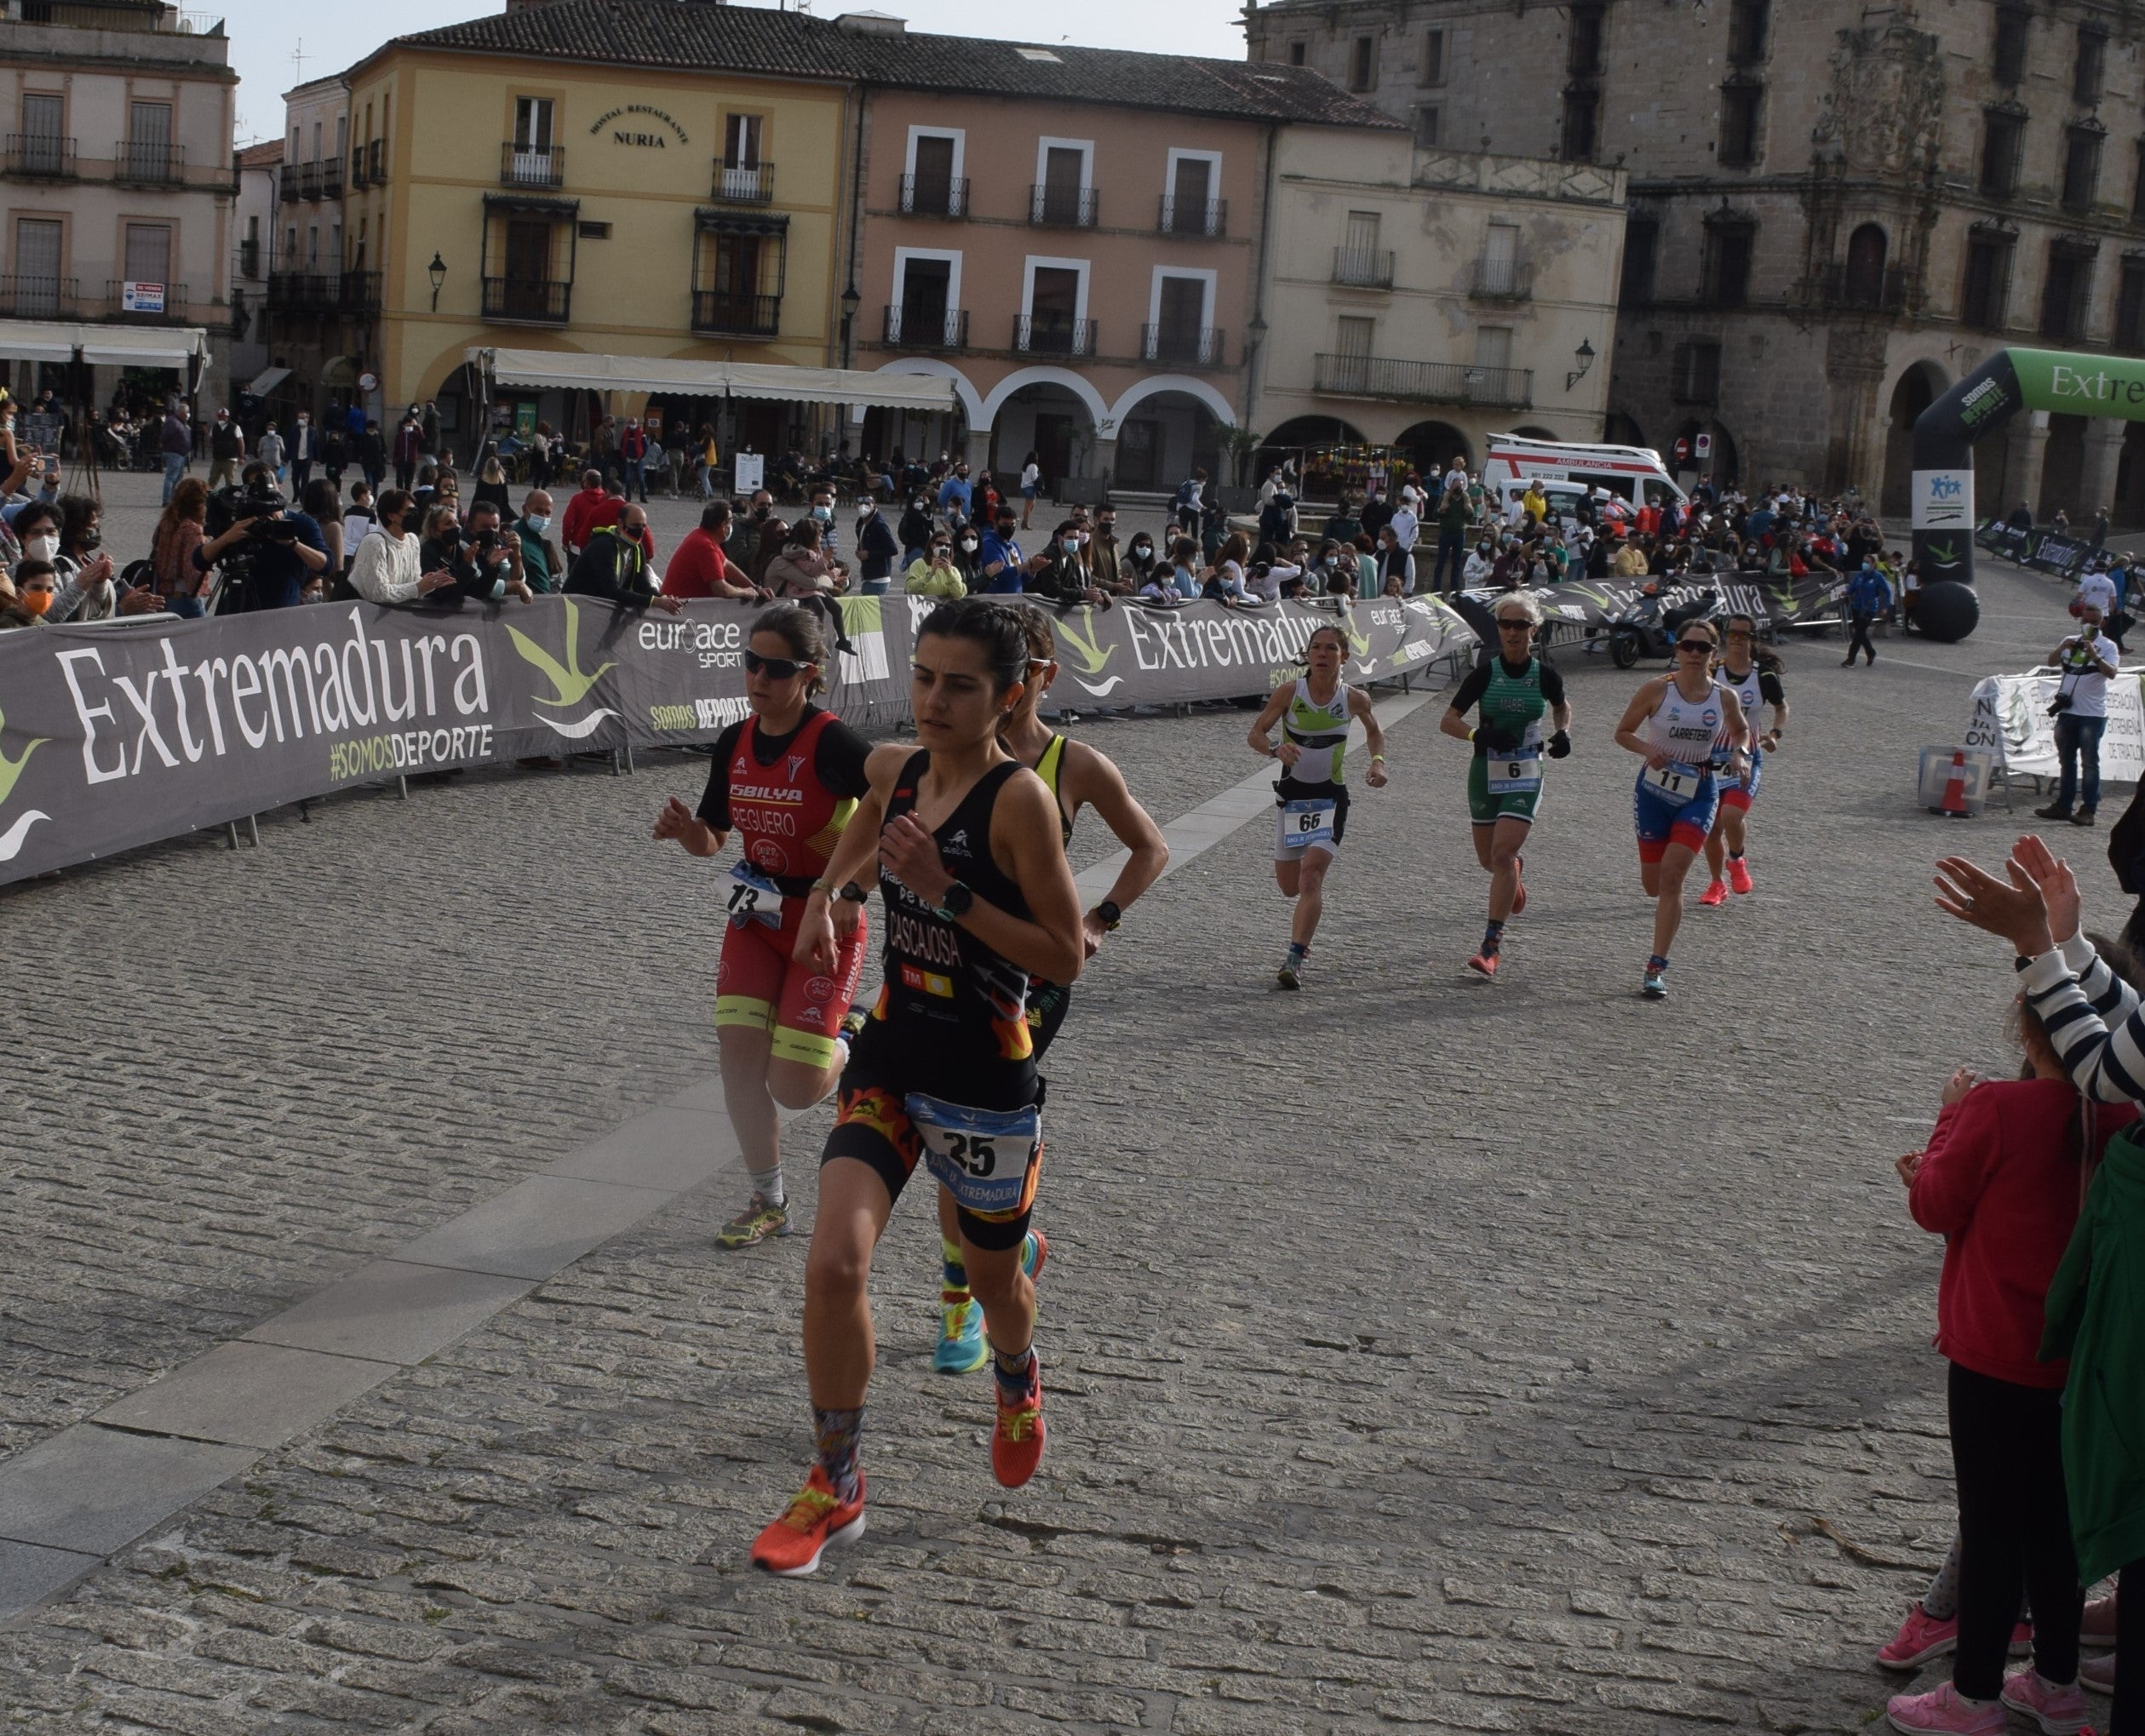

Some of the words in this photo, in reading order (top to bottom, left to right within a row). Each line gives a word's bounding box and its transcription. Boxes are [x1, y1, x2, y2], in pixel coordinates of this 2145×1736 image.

[590, 108, 623, 135] HOSTAL
[627, 105, 689, 145] RESTAURANTE
[614, 132, 665, 148] NURIA
[1960, 385, 2006, 426] DEPORTE
[1556, 458, 1612, 469] AMBULANCIA
[698, 652, 742, 668] SPORT
[55, 606, 489, 784] Extremadura
[651, 704, 697, 730] SOMOS
[695, 696, 753, 730] DEPORTE
[1500, 698, 1527, 713] MABEL
[1669, 726, 1712, 742] CARRETERO
[330, 724, 494, 782] #SOMOSDEPORTE
[1508, 762, 1521, 778] 6
[1660, 771, 1681, 791] 11
[730, 783, 803, 801] ISBILYA
[732, 807, 795, 837] REGUERO
[1299, 813, 1321, 832] 66
[727, 884, 760, 913] 13
[890, 910, 963, 968] CASCAJOSA
[904, 970, 921, 985] TM
[943, 1132, 995, 1177] 25
[959, 1183, 1018, 1201] XTREMADURA
